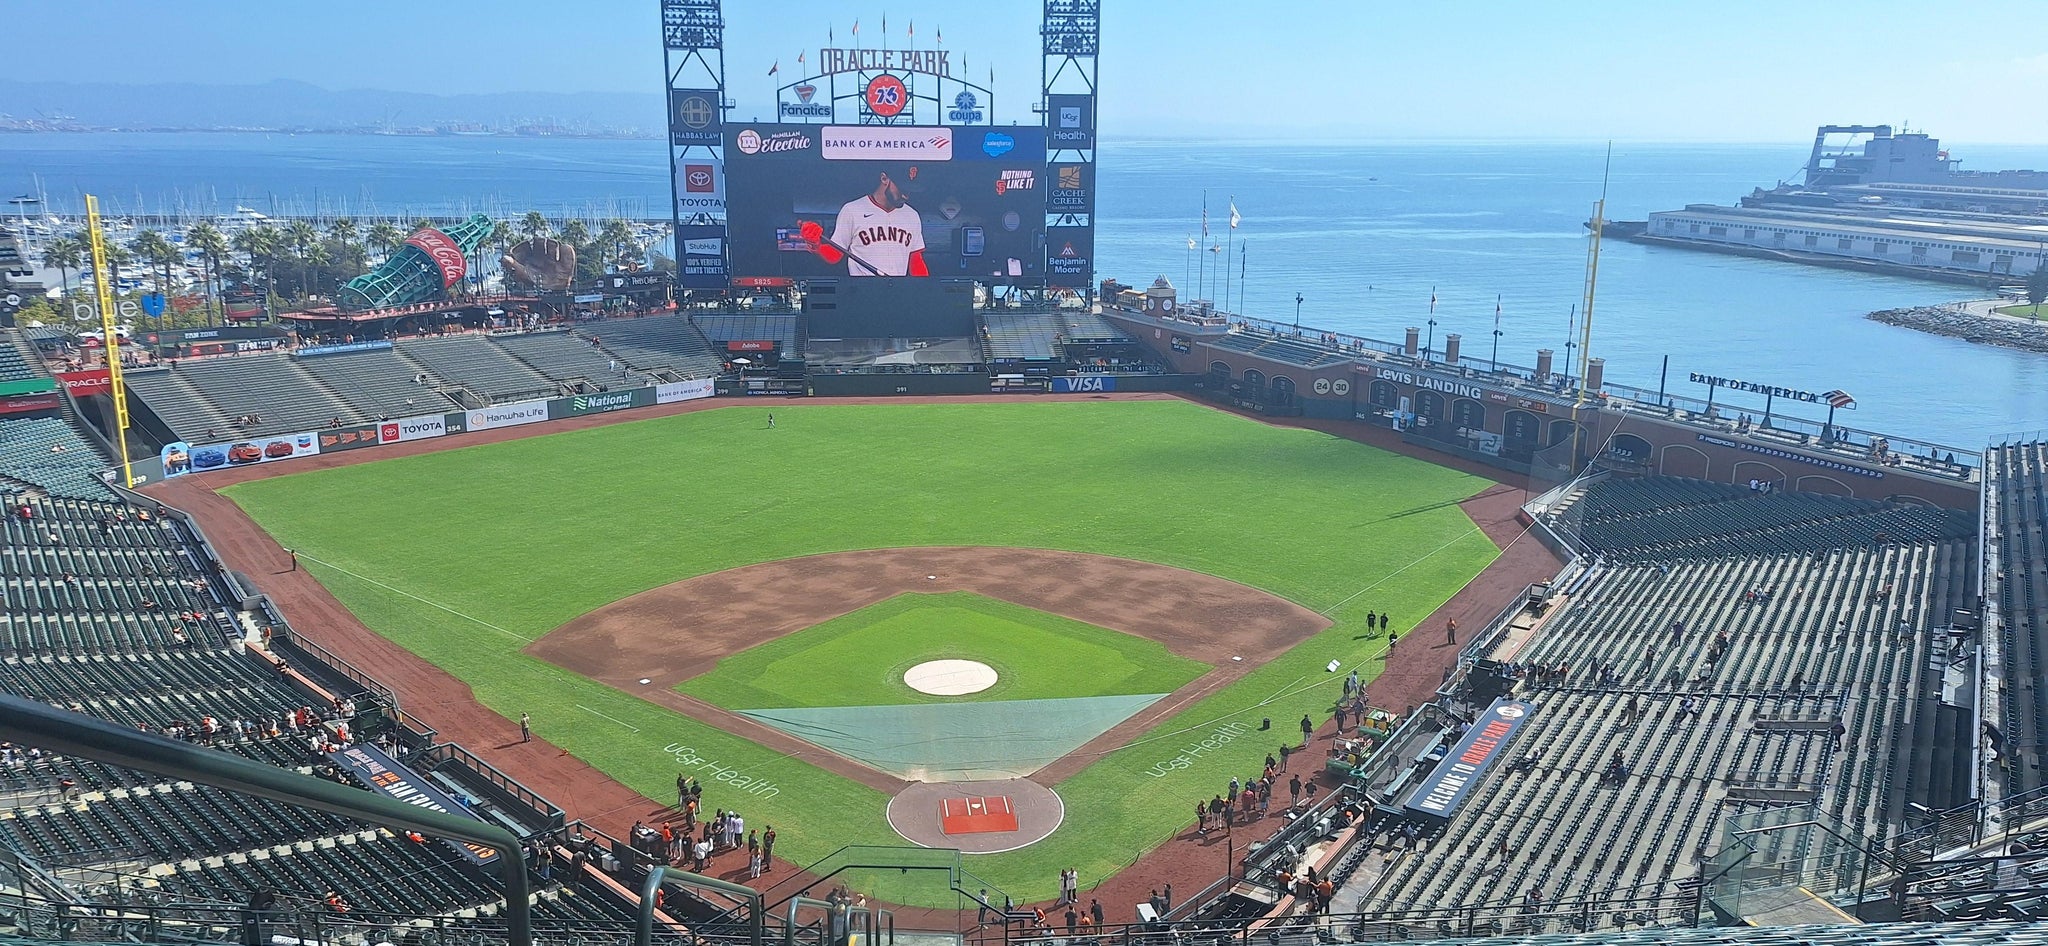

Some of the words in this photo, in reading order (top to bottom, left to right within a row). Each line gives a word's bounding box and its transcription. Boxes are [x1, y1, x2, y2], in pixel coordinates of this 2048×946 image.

[820, 48, 893, 75] ORACLE
[902, 51, 950, 79] PARK
[875, 86, 898, 106] 76
[781, 103, 831, 118] Fanatics
[950, 111, 982, 123] coupa
[1062, 113, 1079, 122] UCSF
[676, 132, 703, 140] HABBAS
[704, 132, 719, 140] LAW
[1053, 131, 1086, 141] Health
[761, 135, 811, 153] Electric
[825, 140, 855, 148] BANK
[859, 140, 873, 149] OF
[875, 140, 926, 149] AMERICA
[986, 140, 1012, 148] salesforce
[1001, 170, 1033, 180] NOTHING
[1006, 179, 1025, 190] LIKE
[1025, 178, 1035, 189] IT
[1052, 189, 1086, 197] CACHE
[680, 198, 722, 207] TOYOTA
[1053, 197, 1085, 205] CREEK
[859, 226, 913, 247] GIANTS
[689, 242, 717, 250] StubHub
[686, 258, 700, 266] 100%
[700, 258, 722, 266] VERIFIED
[1049, 257, 1086, 267] Benjamin
[685, 266, 703, 274] GIANTS
[703, 266, 724, 274] TICKETS
[644, 276, 658, 285] Coffee
[1065, 378, 1104, 391] VISA
[1415, 375, 1482, 400] LANDING
[1690, 372, 1727, 388] BANK
[1730, 379, 1750, 391] OF
[1750, 383, 1818, 403] AMERICA
[680, 387, 702, 396] AMERICA
[588, 392, 632, 408] National
[614, 402, 631, 410] Rental
[487, 410, 525, 423] Hanwha
[527, 407, 544, 418] Life
[402, 421, 442, 434] TOYOTA
[447, 425, 461, 433] 354
[132, 475, 147, 485] 339
[1481, 719, 1513, 739] PARK
[1145, 755, 1193, 778] UCSF
[1180, 720, 1251, 758] Health
[1460, 737, 1498, 765] ORACLE
[663, 742, 706, 766] UCSF
[697, 760, 780, 800] Health
[1451, 763, 1477, 775] TO
[384, 781, 418, 799] SAN
[1421, 773, 1469, 811] WELCOME
